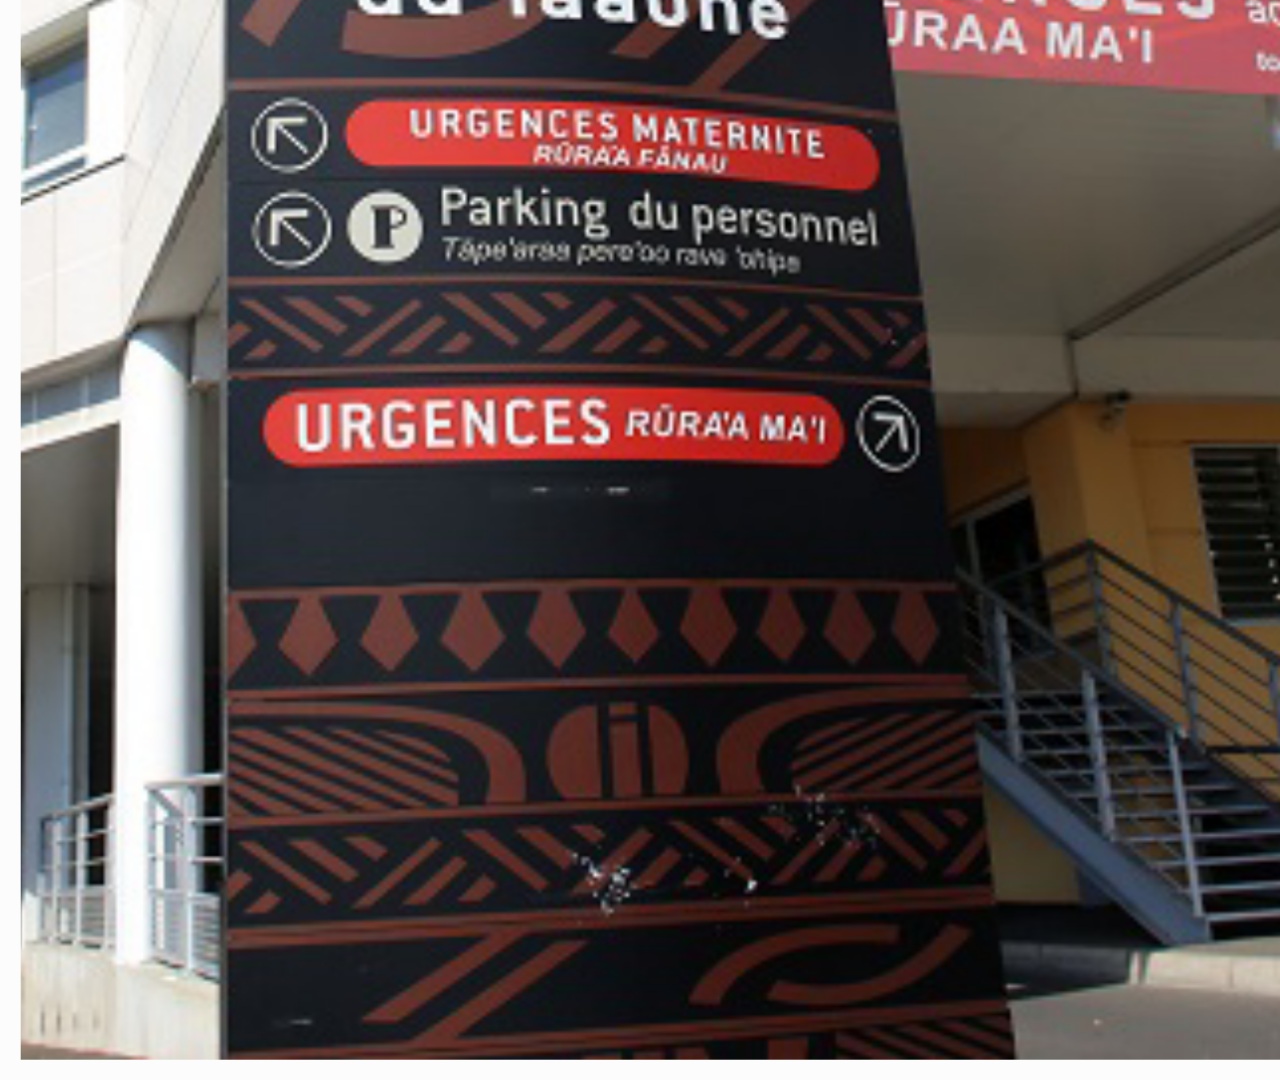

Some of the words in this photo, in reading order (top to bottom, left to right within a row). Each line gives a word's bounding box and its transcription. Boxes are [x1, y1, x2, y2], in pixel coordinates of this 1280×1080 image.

[1046, 20, 1154, 64] MA'I
[409, 109, 618, 142] URGENCES
[633, 112, 825, 159] MATERNITE
[441, 186, 606, 238] Parking
[629, 191, 679, 232] du
[692, 203, 878, 247] personnel
[296, 397, 611, 452] URGENCES
[758, 412, 826, 445] MA'I
